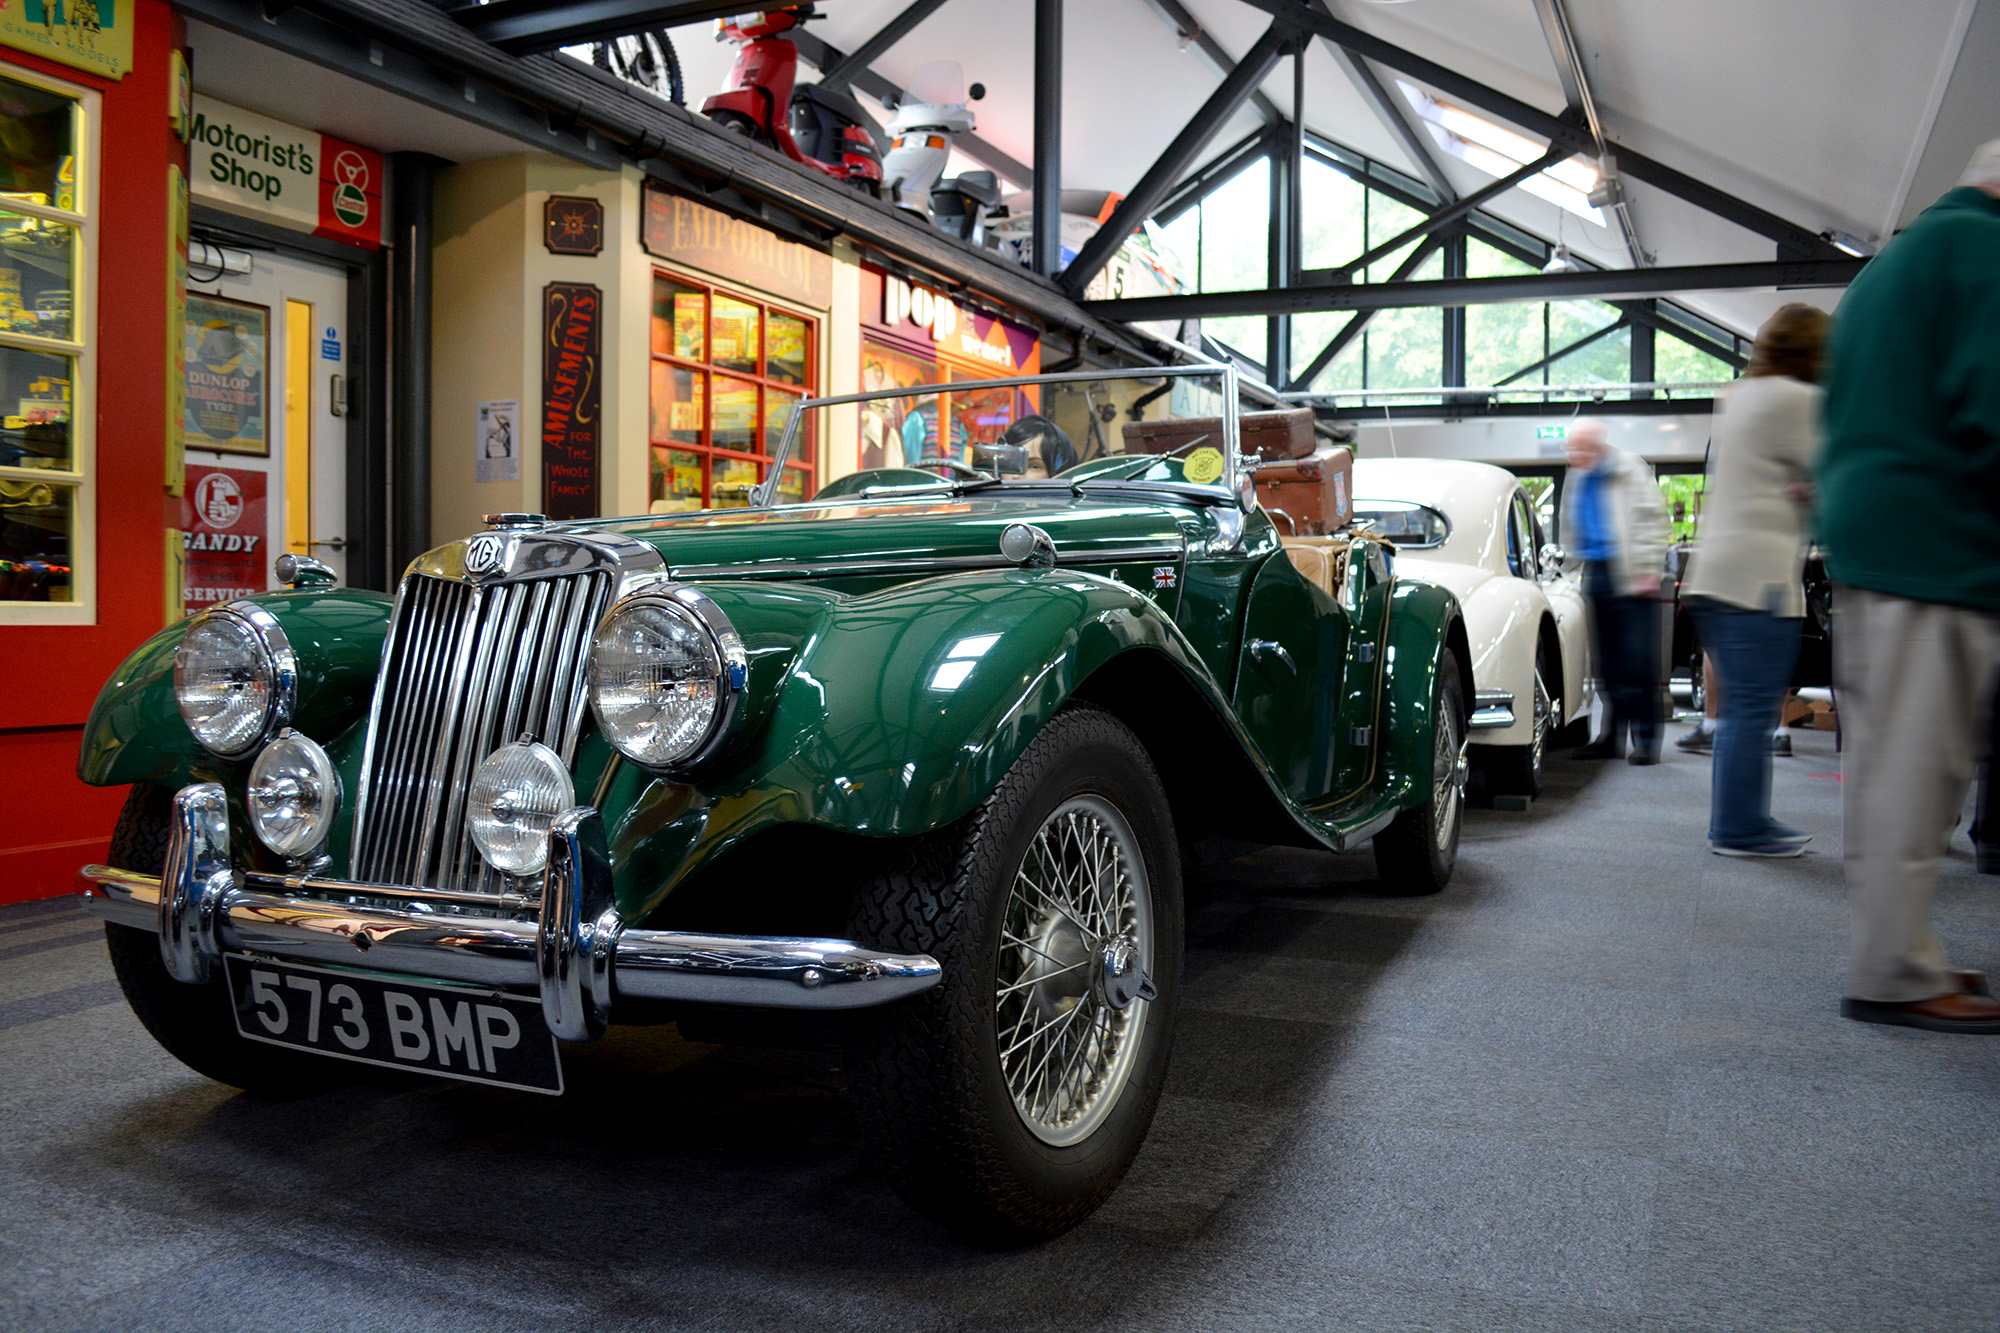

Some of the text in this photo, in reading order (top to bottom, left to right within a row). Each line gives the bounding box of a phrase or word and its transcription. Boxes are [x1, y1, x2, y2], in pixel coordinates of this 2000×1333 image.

[4, 22, 120, 67] GAMES MODELS
[191, 112, 313, 175] Motorist's
[209, 151, 281, 200] Shop
[671, 194, 812, 297] EMPORIUM
[884, 273, 957, 342] pop
[960, 333, 1012, 367] weasel
[188, 371, 250, 391] DUNLOP
[542, 295, 596, 450] AMUSEMENTS
[205, 401, 236, 413] TYRE
[569, 431, 592, 444] FOR
[551, 464, 589, 478] WHOLE
[551, 480, 591, 500] FAMILY
[181, 531, 260, 553] GANDY
[467, 539, 494, 568] MG
[250, 969, 521, 1073] 573 BMP
